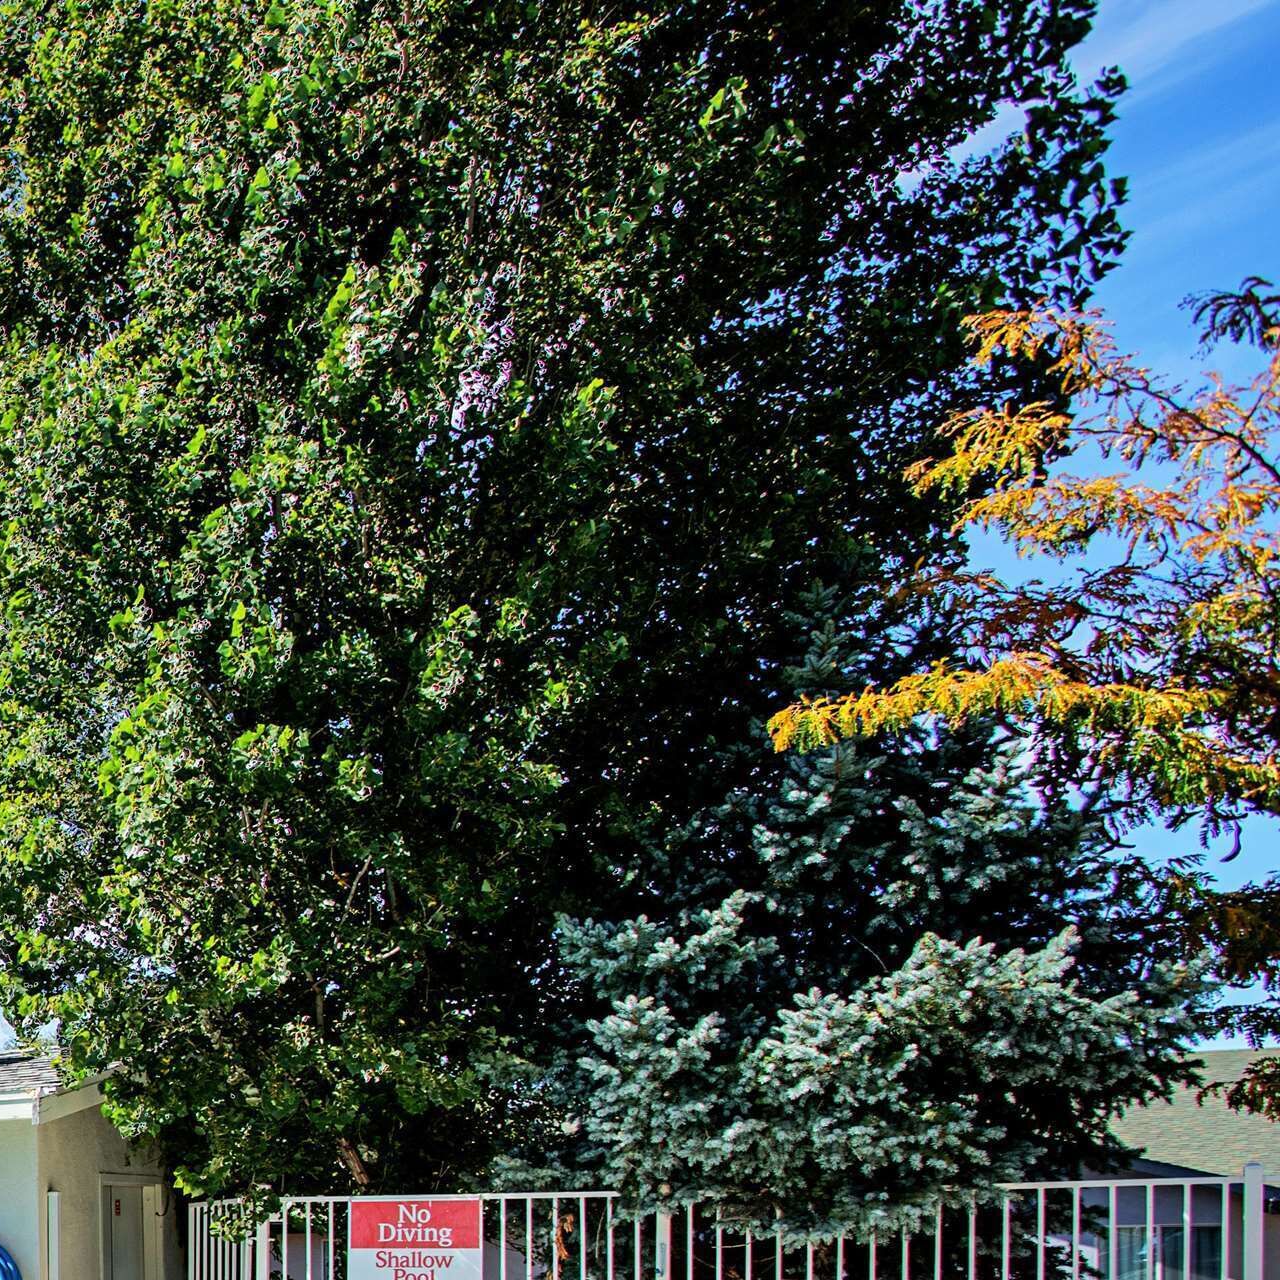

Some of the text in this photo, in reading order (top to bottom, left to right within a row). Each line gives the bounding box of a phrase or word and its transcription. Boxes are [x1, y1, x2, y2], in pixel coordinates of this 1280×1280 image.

[397, 1204, 432, 1224] No
[377, 1223, 454, 1247] Diving
[375, 1250, 454, 1269] Shallow
